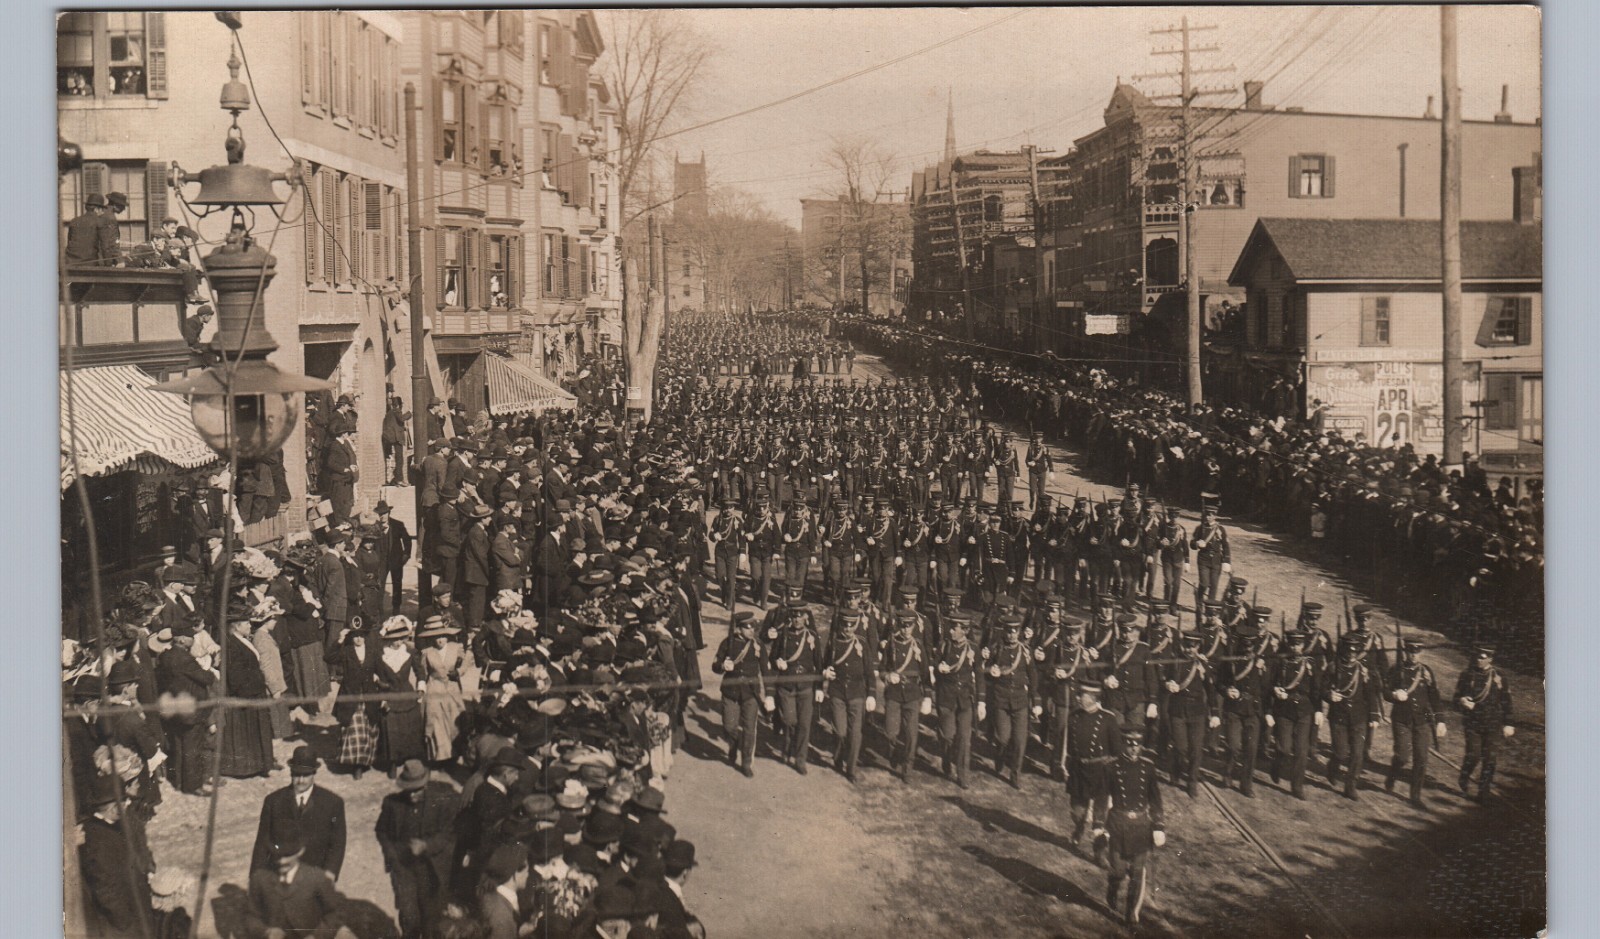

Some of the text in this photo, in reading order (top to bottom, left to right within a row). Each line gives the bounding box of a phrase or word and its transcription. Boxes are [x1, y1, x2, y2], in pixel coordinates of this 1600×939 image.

[1377, 378, 1411, 386] TUESDAY
[1377, 388, 1410, 411] APR
[1377, 412, 1410, 448] 20
